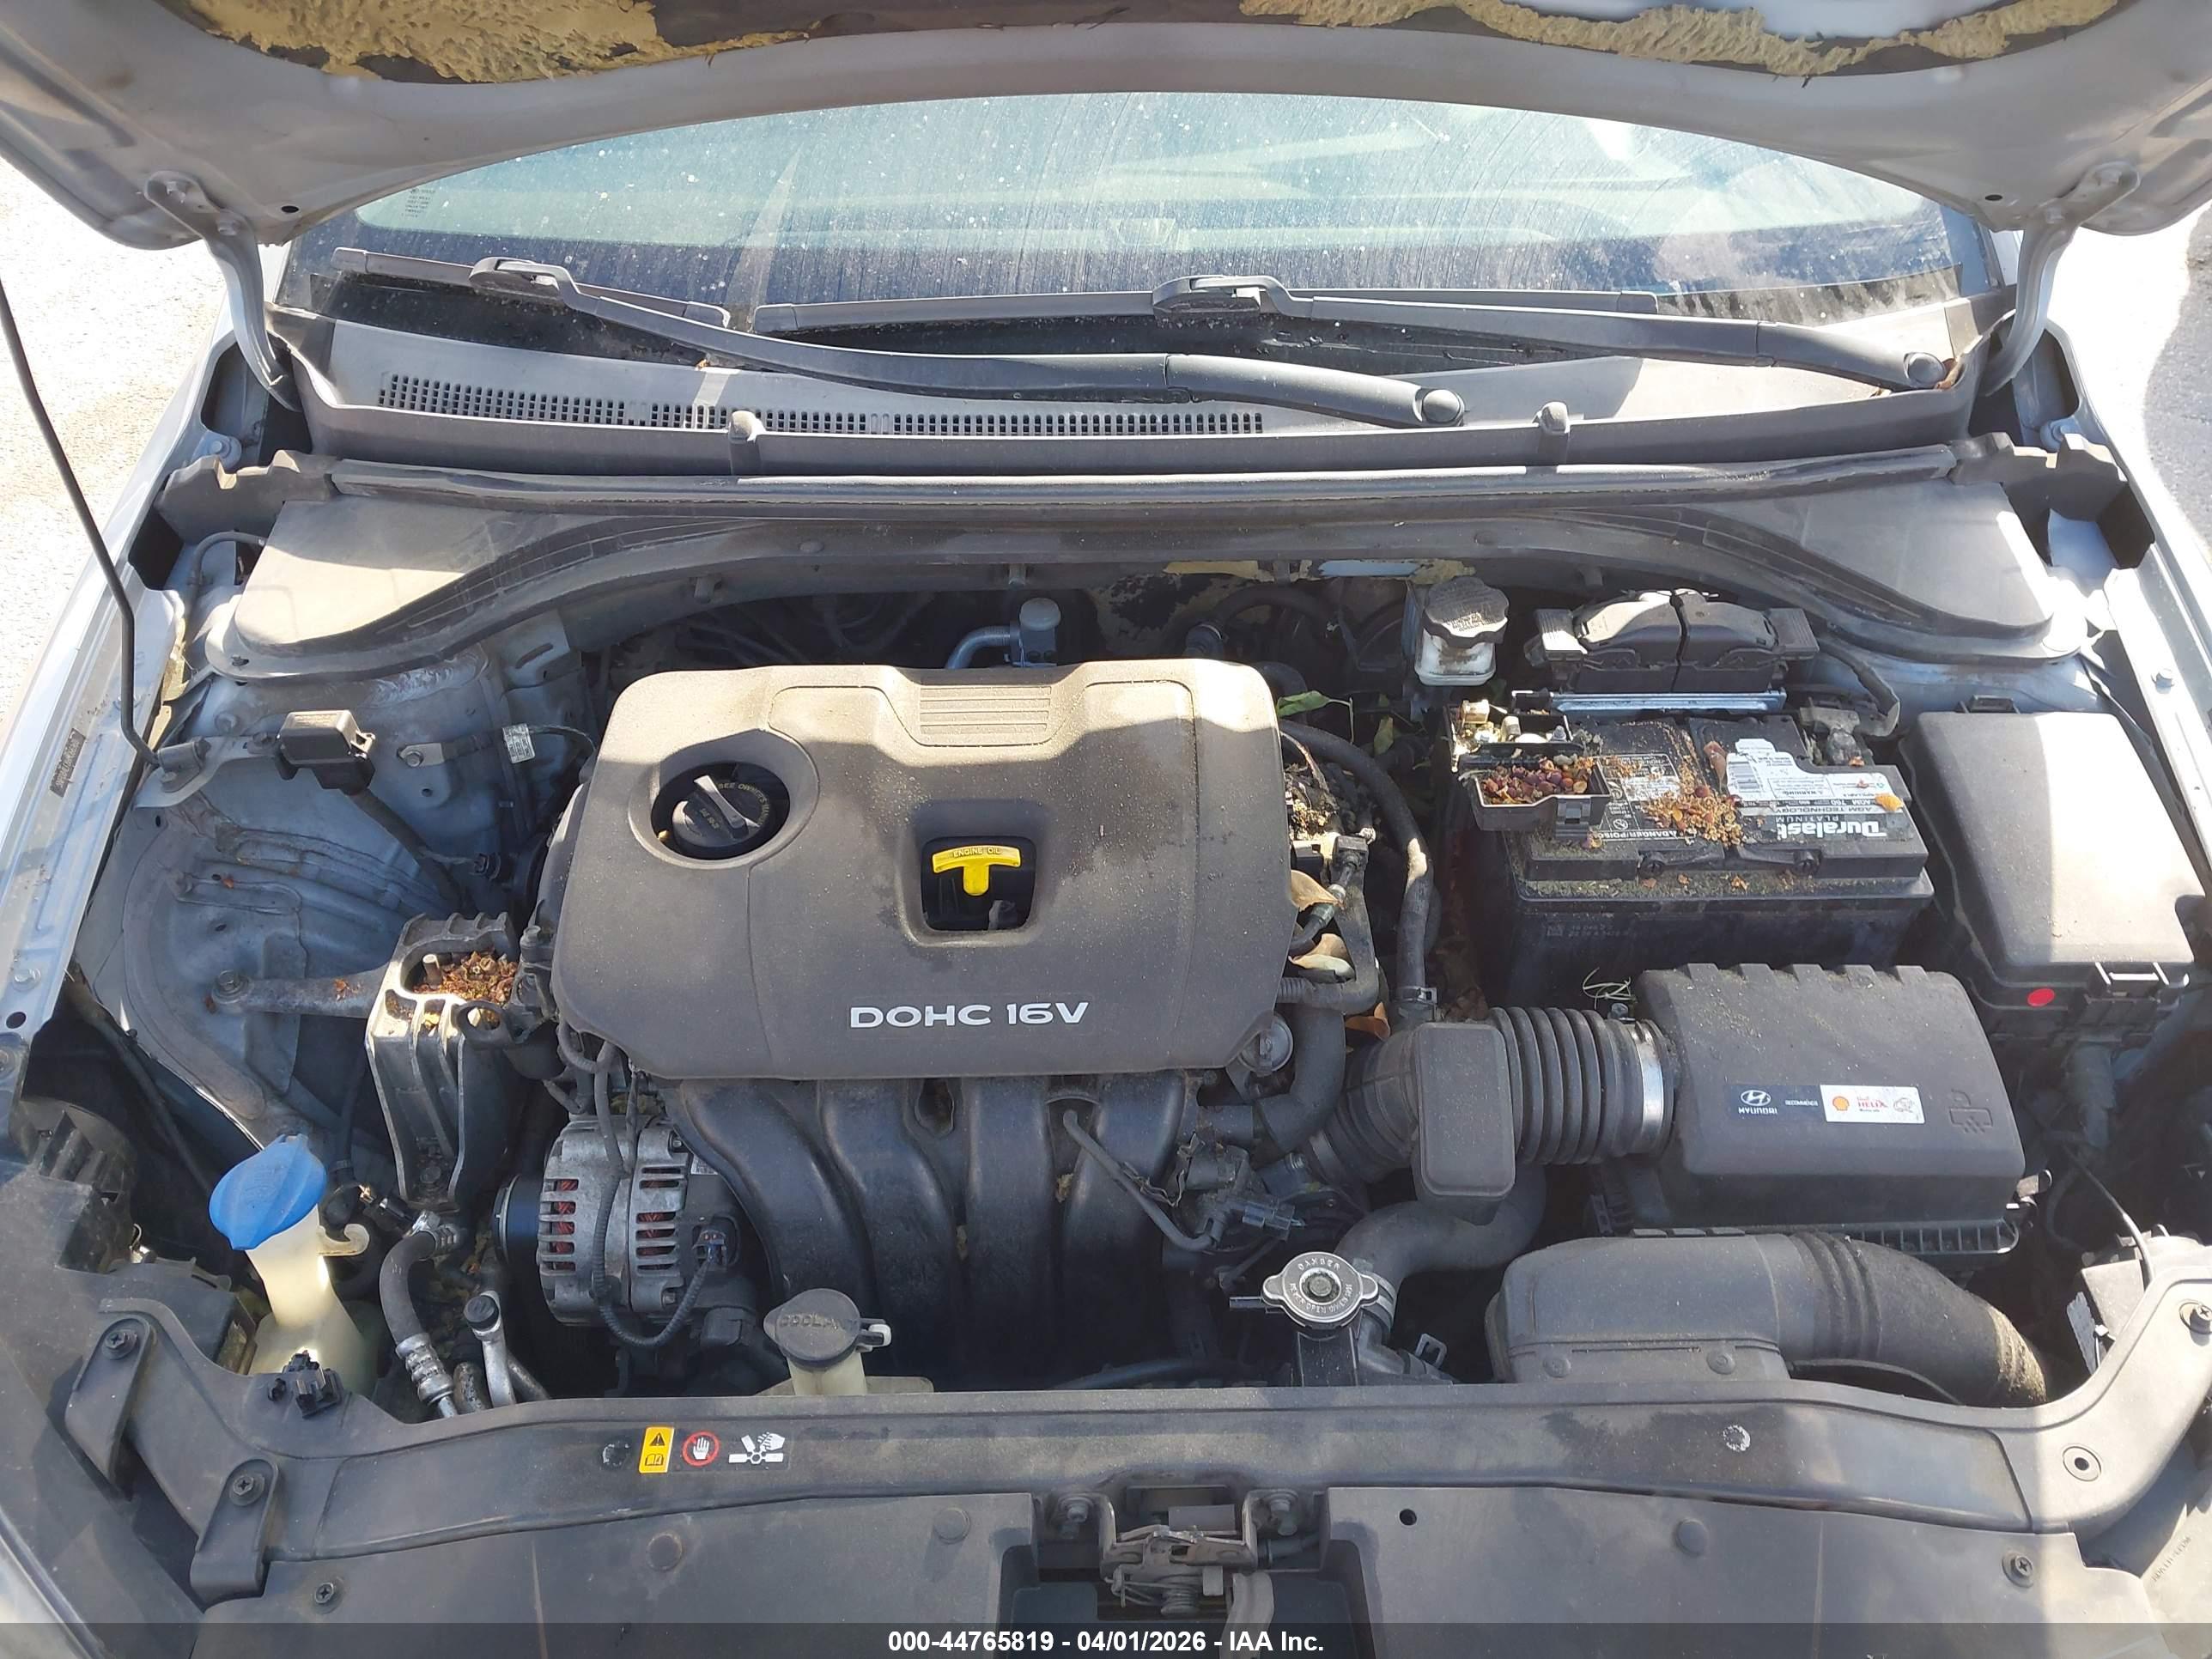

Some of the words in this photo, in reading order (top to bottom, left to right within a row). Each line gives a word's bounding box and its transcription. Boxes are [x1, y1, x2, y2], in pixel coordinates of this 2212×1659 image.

[1597, 830, 1669, 839] DANGER/POISO
[1776, 820, 1887, 840] Duralast
[952, 847, 983, 858] ENGINE
[987, 847, 1001, 855] OIL
[849, 1005, 992, 1029] DOHC
[1006, 1001, 1090, 1025] 16V
[1856, 1099, 1889, 1108] HELIX
[1738, 1106, 1778, 1115] HYUNDAI
